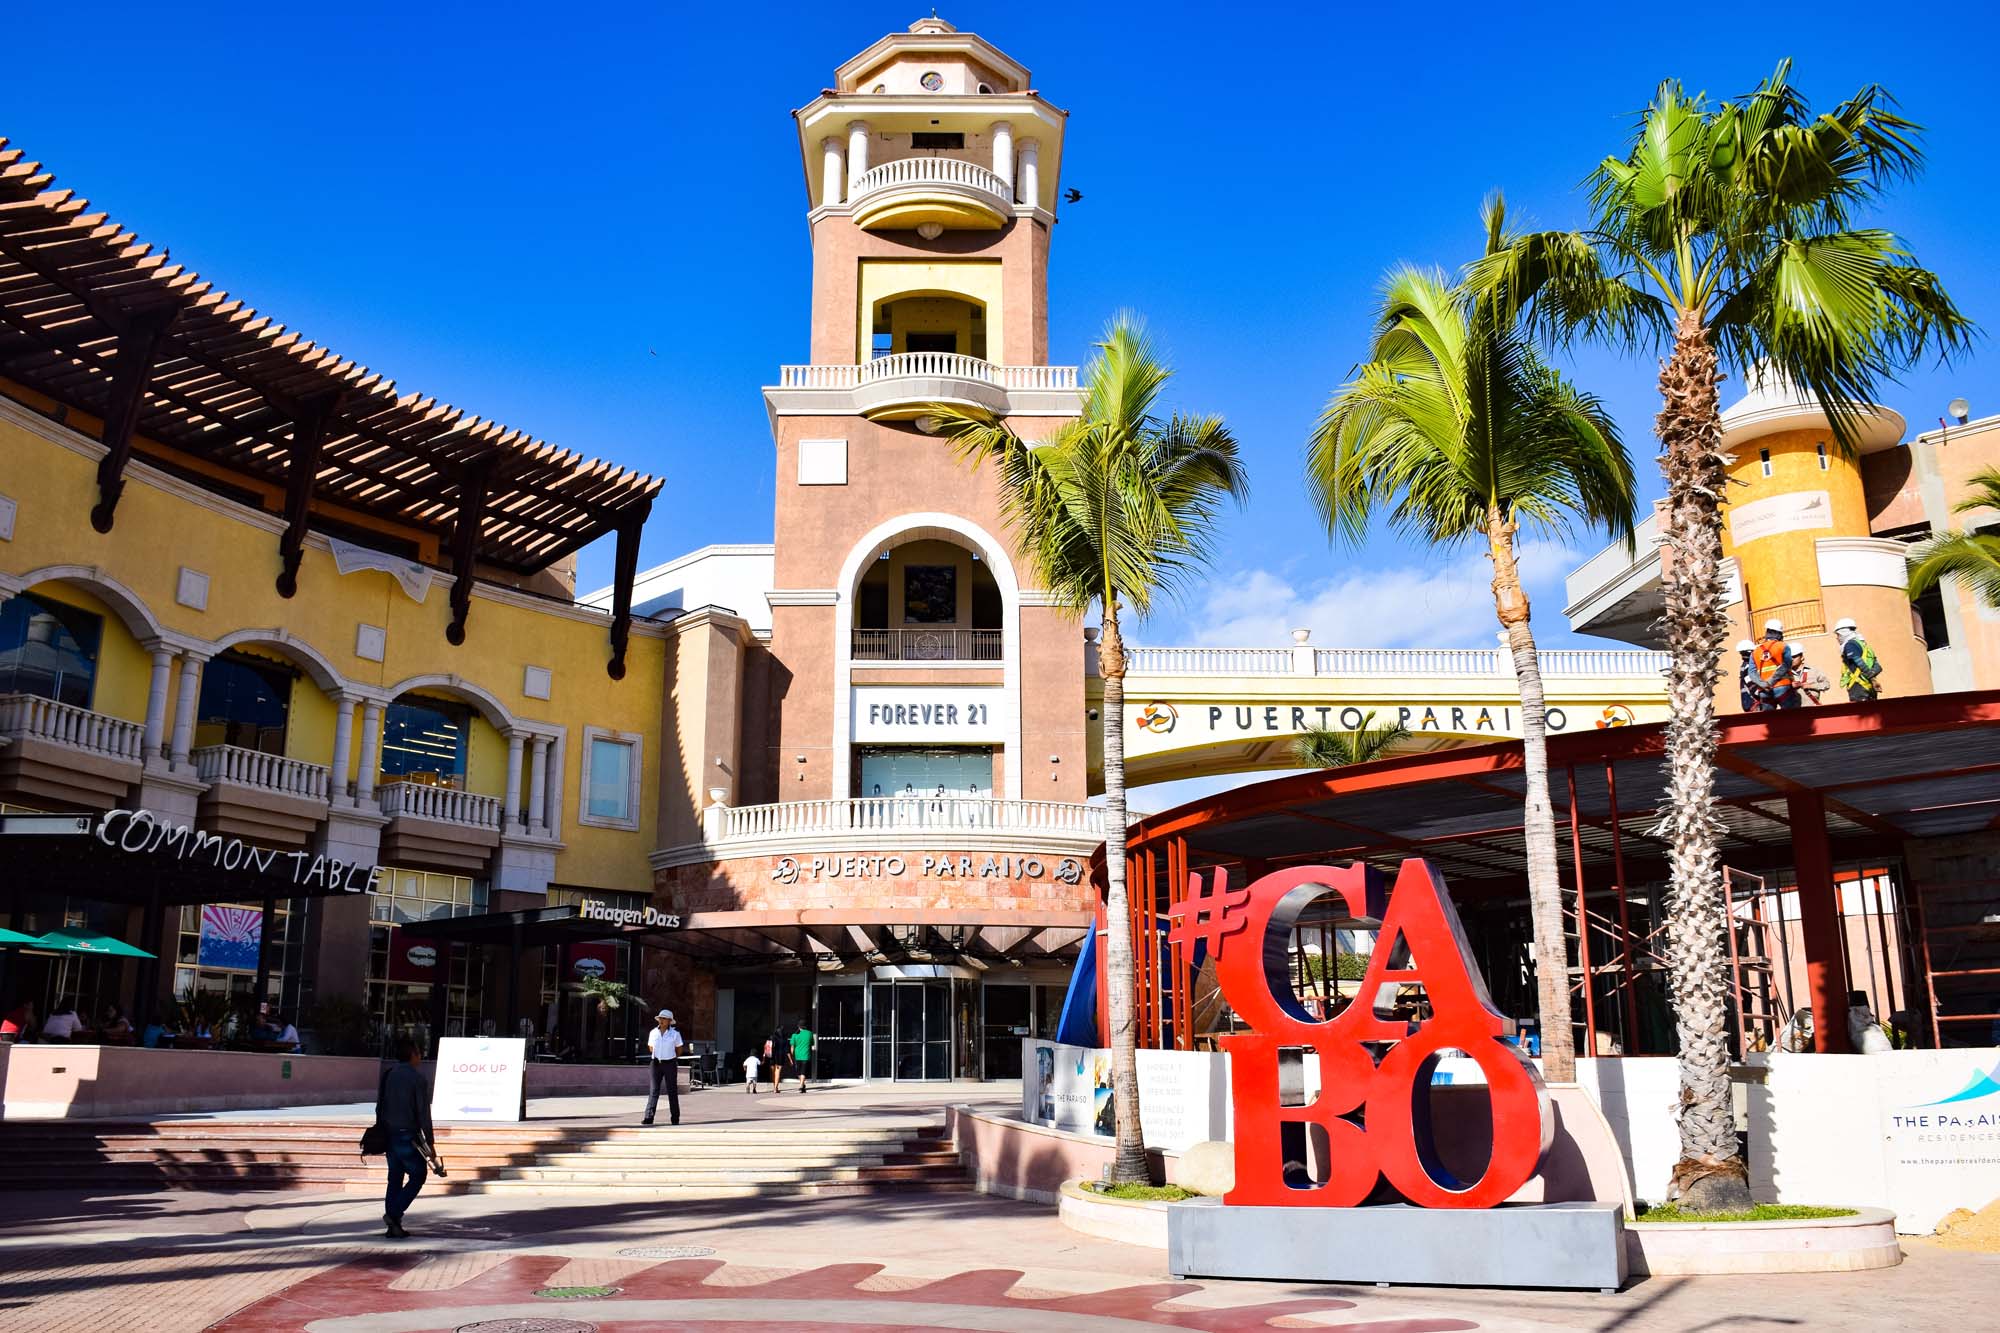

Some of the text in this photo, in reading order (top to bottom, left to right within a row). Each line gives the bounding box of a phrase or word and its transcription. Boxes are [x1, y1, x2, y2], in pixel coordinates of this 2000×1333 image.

[869, 703, 988, 725] FOREVER 21
[1209, 706, 1567, 731] PUERTO PARAIO
[97, 809, 386, 896] COMMON TABLE
[811, 856, 1045, 880] PUERTO PARAISO
[452, 1063, 508, 1073] LOOK UP
[1066, 1094, 1087, 1104] PARASO
[1892, 1116, 1929, 1127] THE
